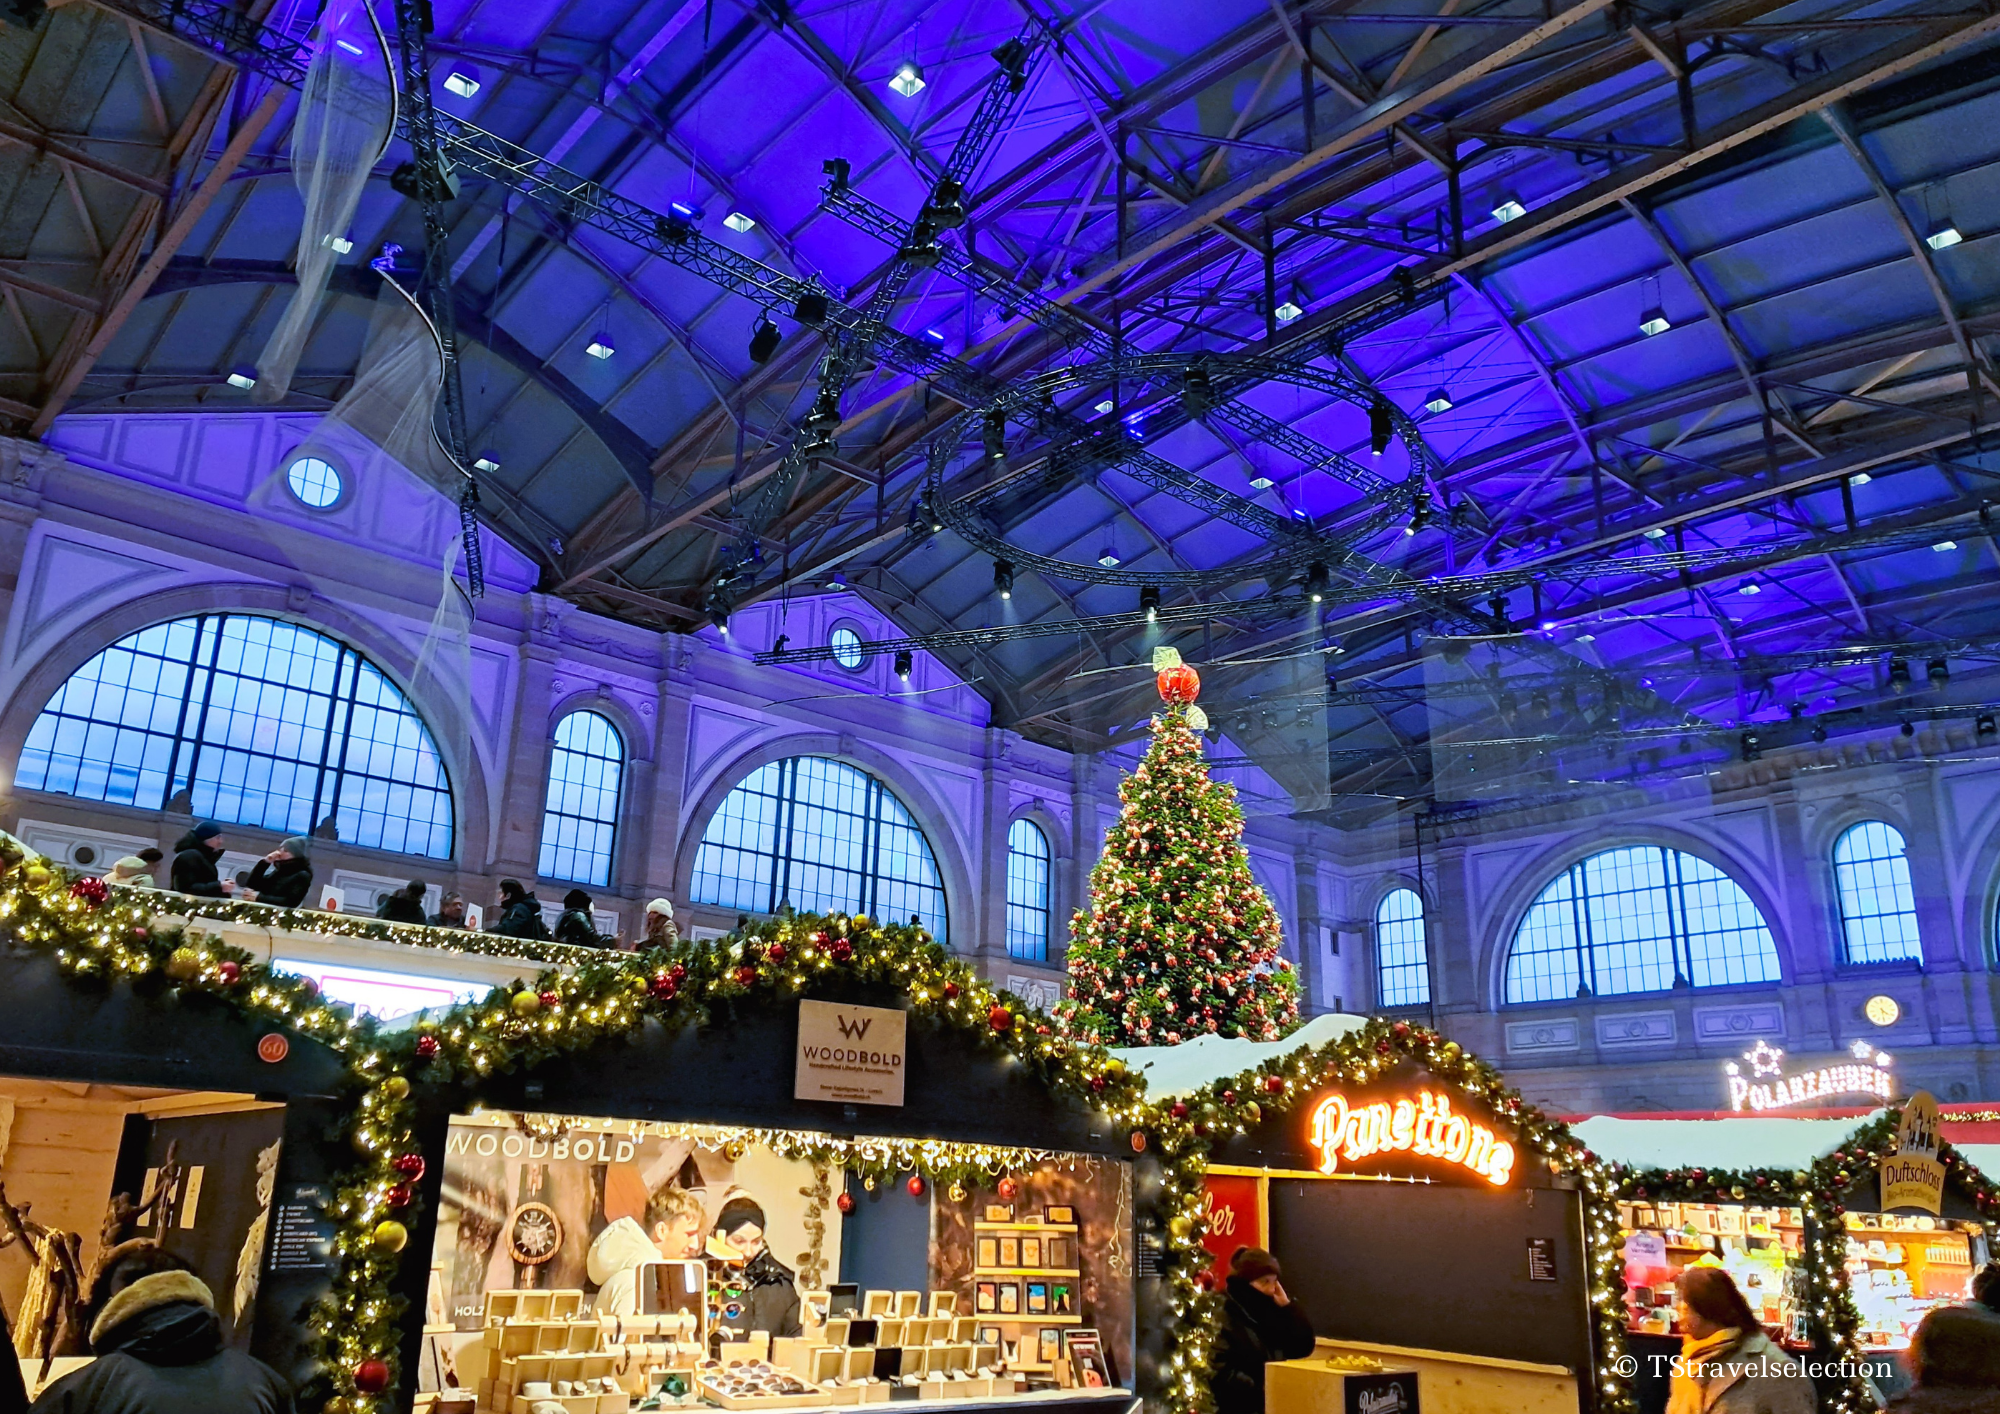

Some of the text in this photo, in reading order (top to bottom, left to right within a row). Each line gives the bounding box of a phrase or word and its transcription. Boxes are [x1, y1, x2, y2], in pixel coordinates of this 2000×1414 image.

[803, 1046, 901, 1066] WOODBOLD
[446, 1132, 635, 1163] WOODBOLD
[1310, 1091, 1515, 1186] Panettone
[1886, 1161, 1941, 1191] Duftschloss
[1205, 1191, 1236, 1236] ber
